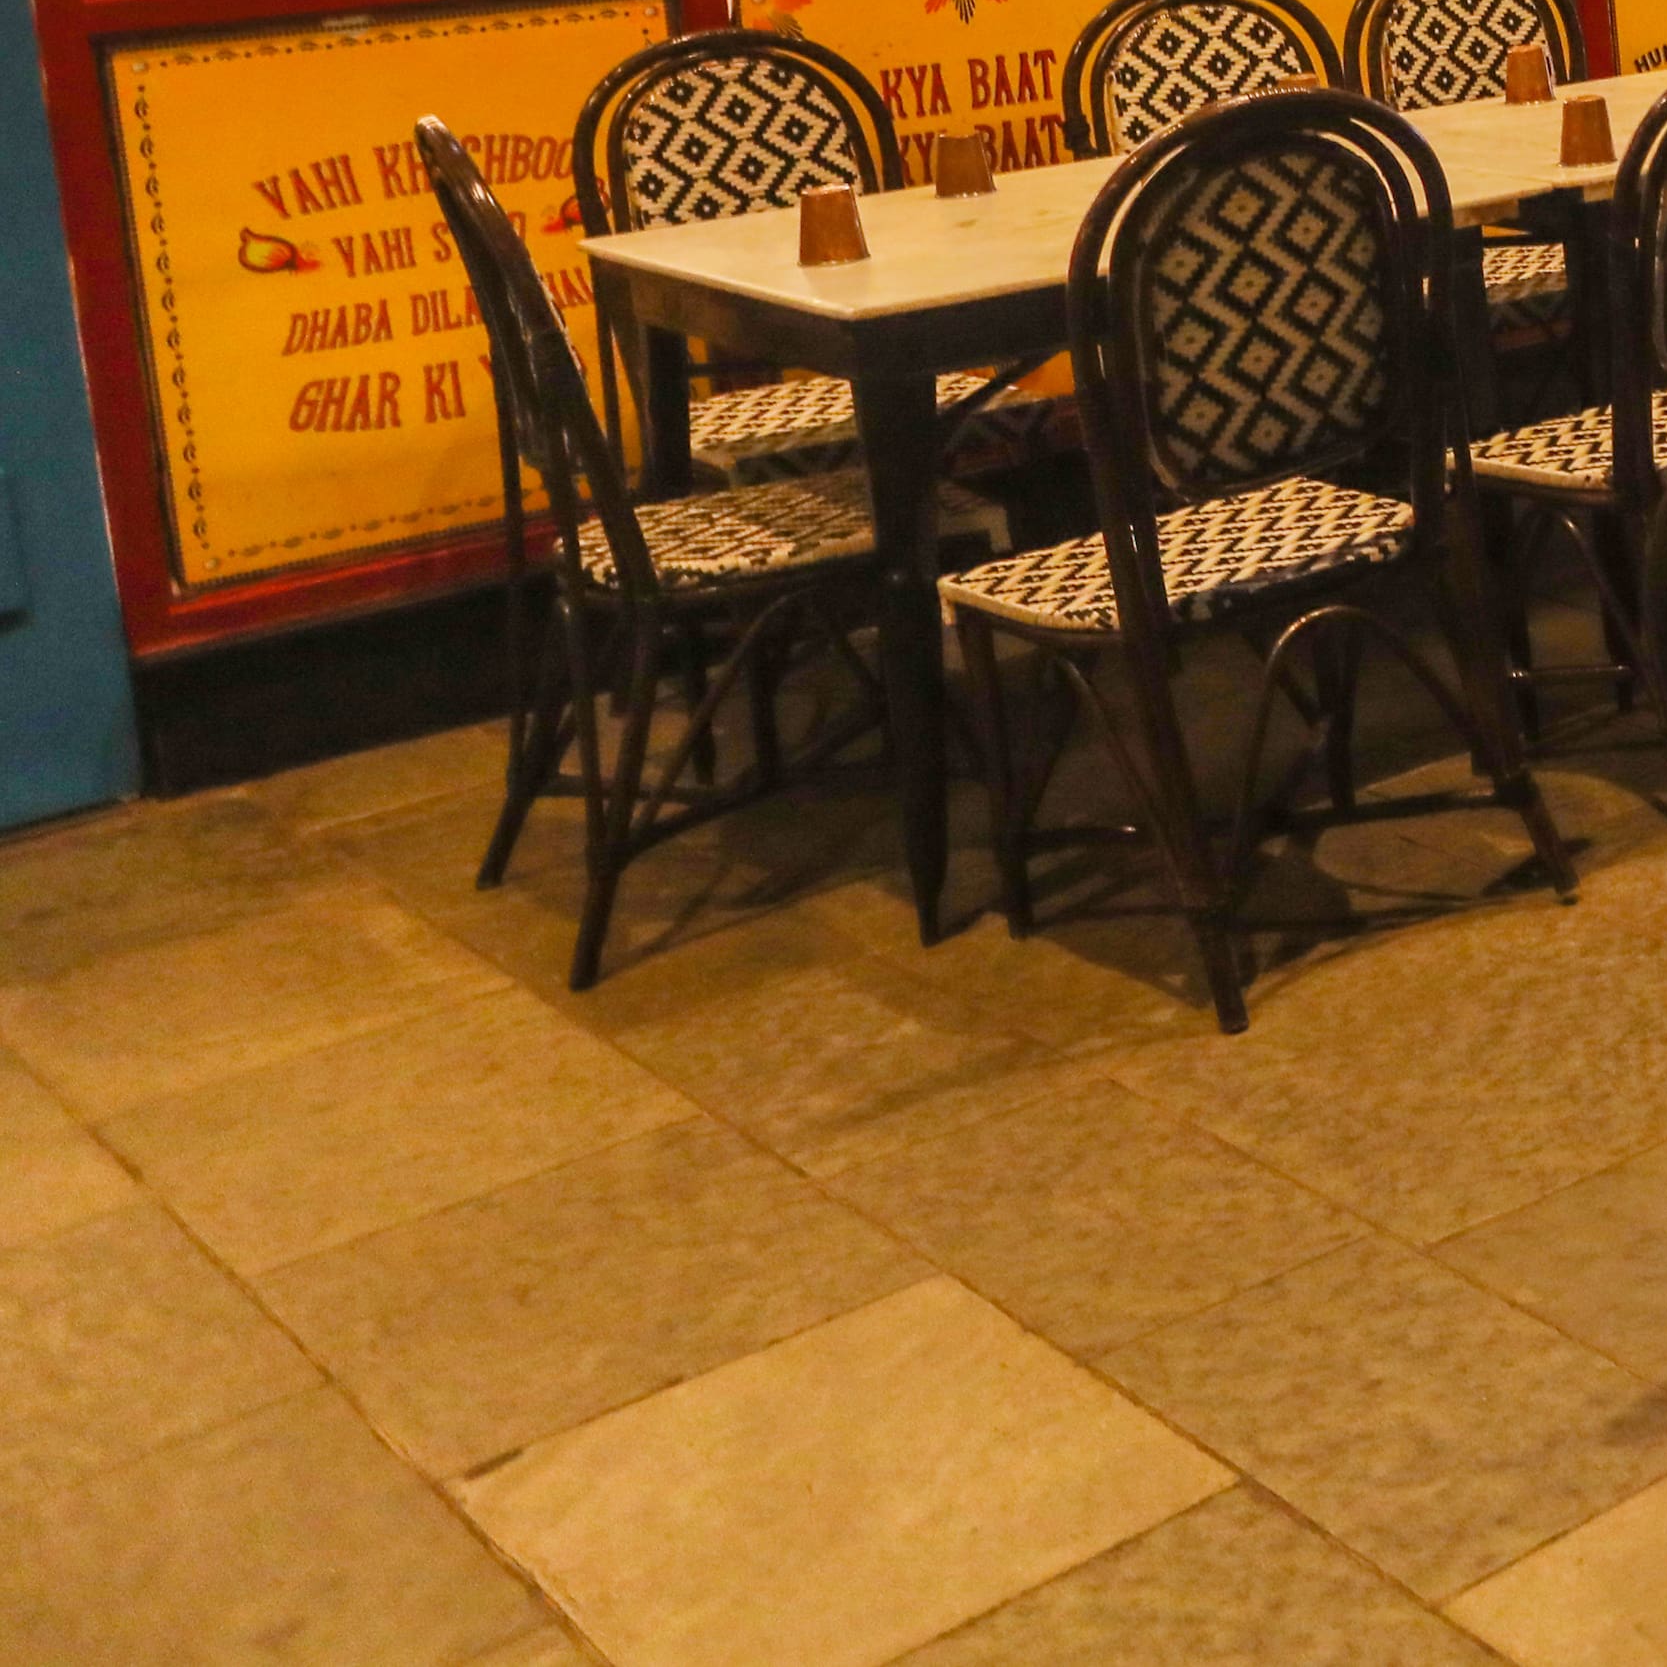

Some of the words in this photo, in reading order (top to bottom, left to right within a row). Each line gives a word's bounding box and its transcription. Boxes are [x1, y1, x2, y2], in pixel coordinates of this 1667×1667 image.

[880, 62, 952, 119] KYA
[967, 49, 1057, 110] BAAT
[254, 154, 363, 220] YAHI
[331, 226, 418, 279] YAHI
[281, 298, 393, 356] DHABA
[289, 371, 402, 433] GHAR
[423, 360, 466, 423] KI
